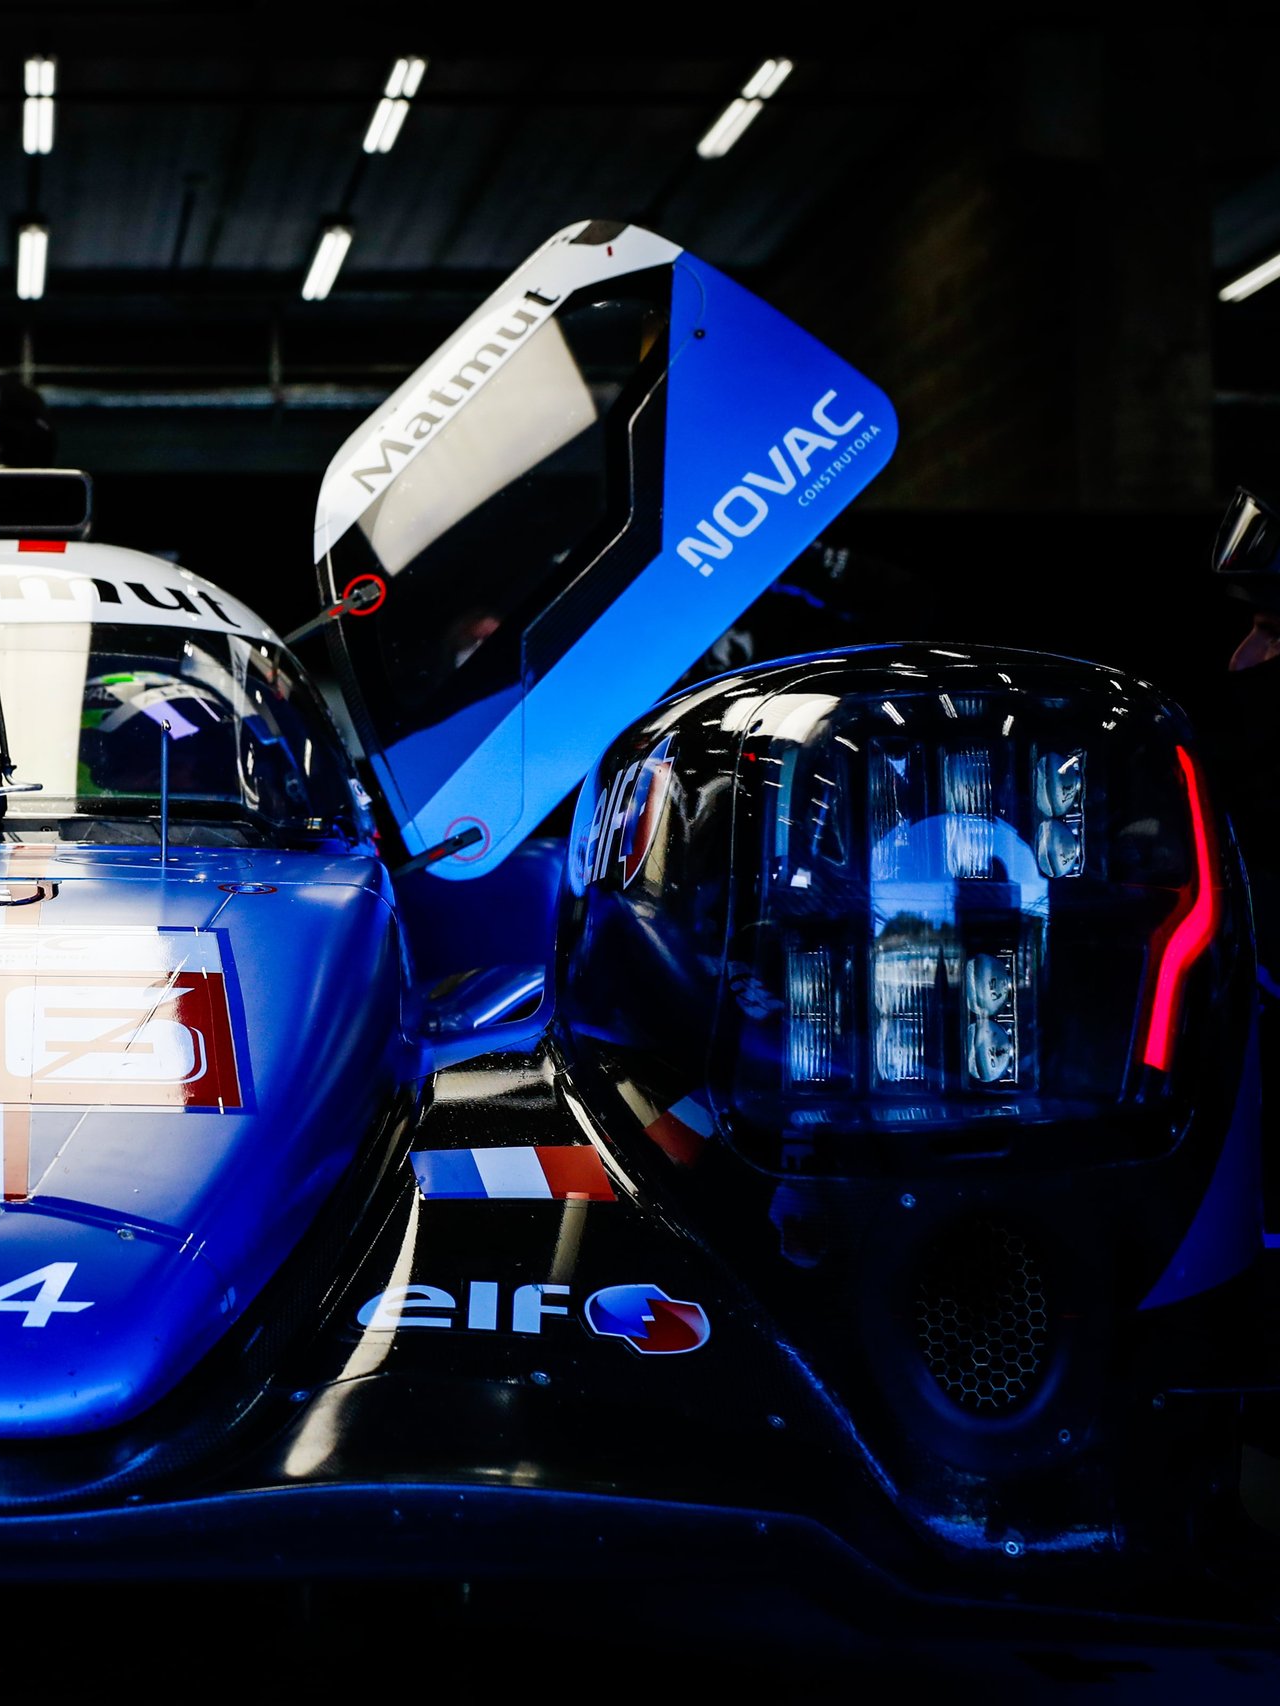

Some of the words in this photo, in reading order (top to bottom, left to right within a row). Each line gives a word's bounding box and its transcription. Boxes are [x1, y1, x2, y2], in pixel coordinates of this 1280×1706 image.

[351, 288, 561, 494] Matmut
[676, 389, 864, 577] NOVAC
[798, 424, 881, 507] CONSTRUTORA
[583, 760, 641, 887] elf
[356, 1281, 571, 1335] elf
